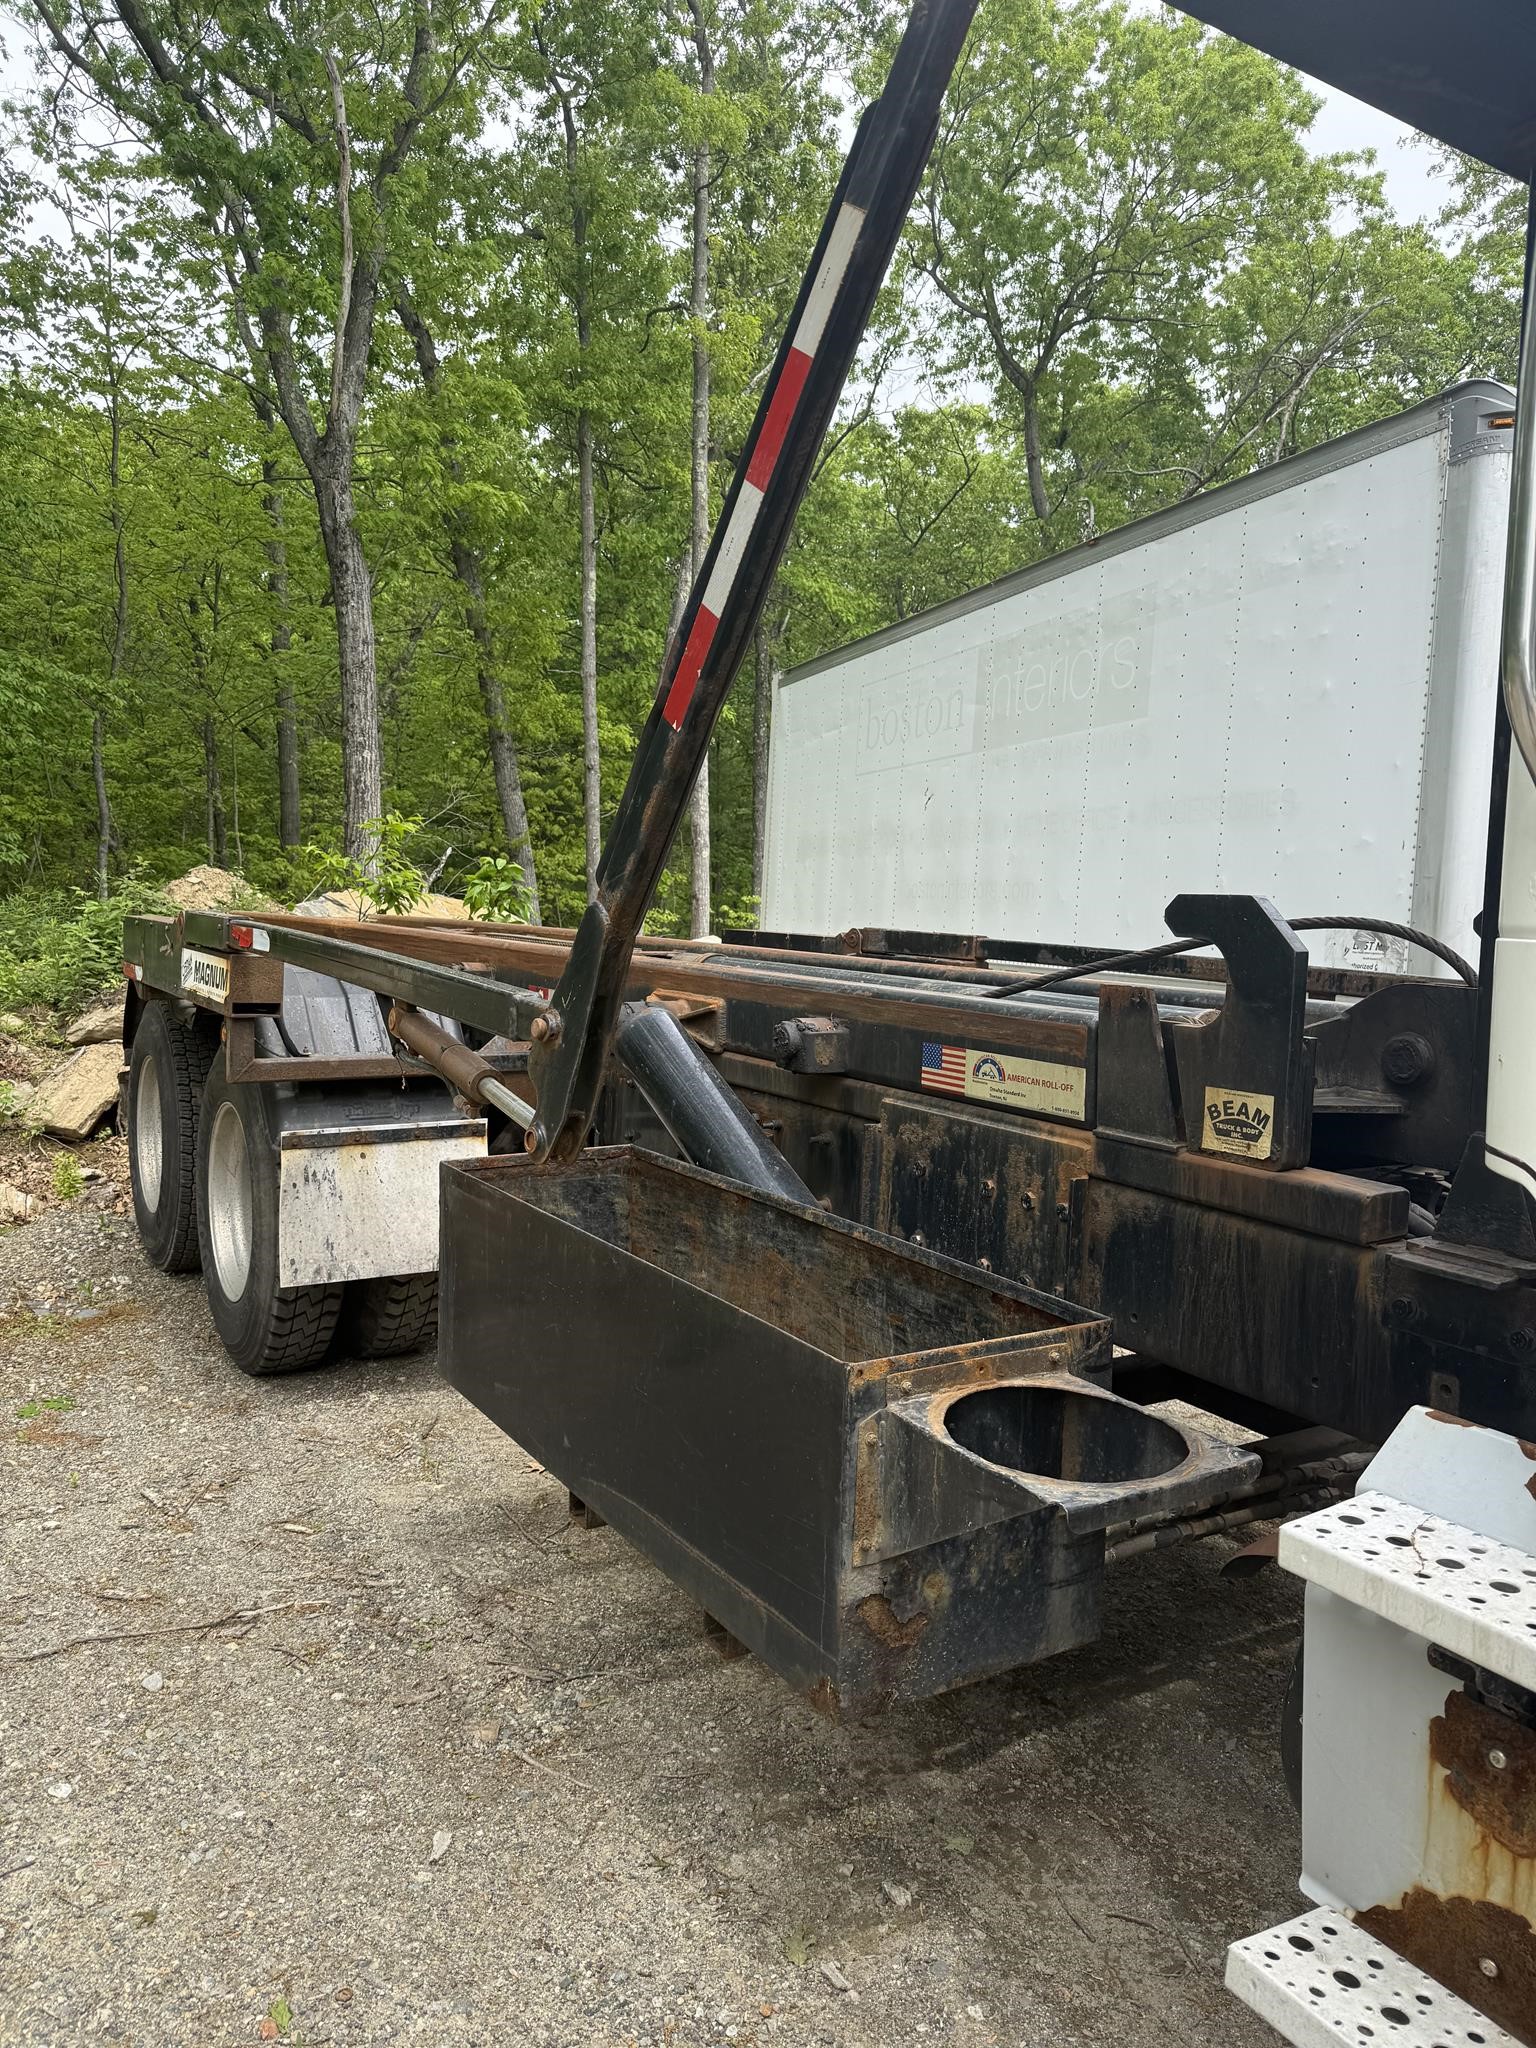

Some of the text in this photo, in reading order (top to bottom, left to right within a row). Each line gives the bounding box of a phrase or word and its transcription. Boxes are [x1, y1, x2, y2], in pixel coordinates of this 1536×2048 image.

[864, 635, 1136, 752] boston nteriors
[193, 960, 229, 991] MAGNUM
[1007, 1073, 1074, 1092] AMERICAN ROLL-OFF
[1206, 1100, 1271, 1130] BEAM
[1216, 1122, 1235, 1131] TRUCK
[1242, 1127, 1260, 1136] BODY
